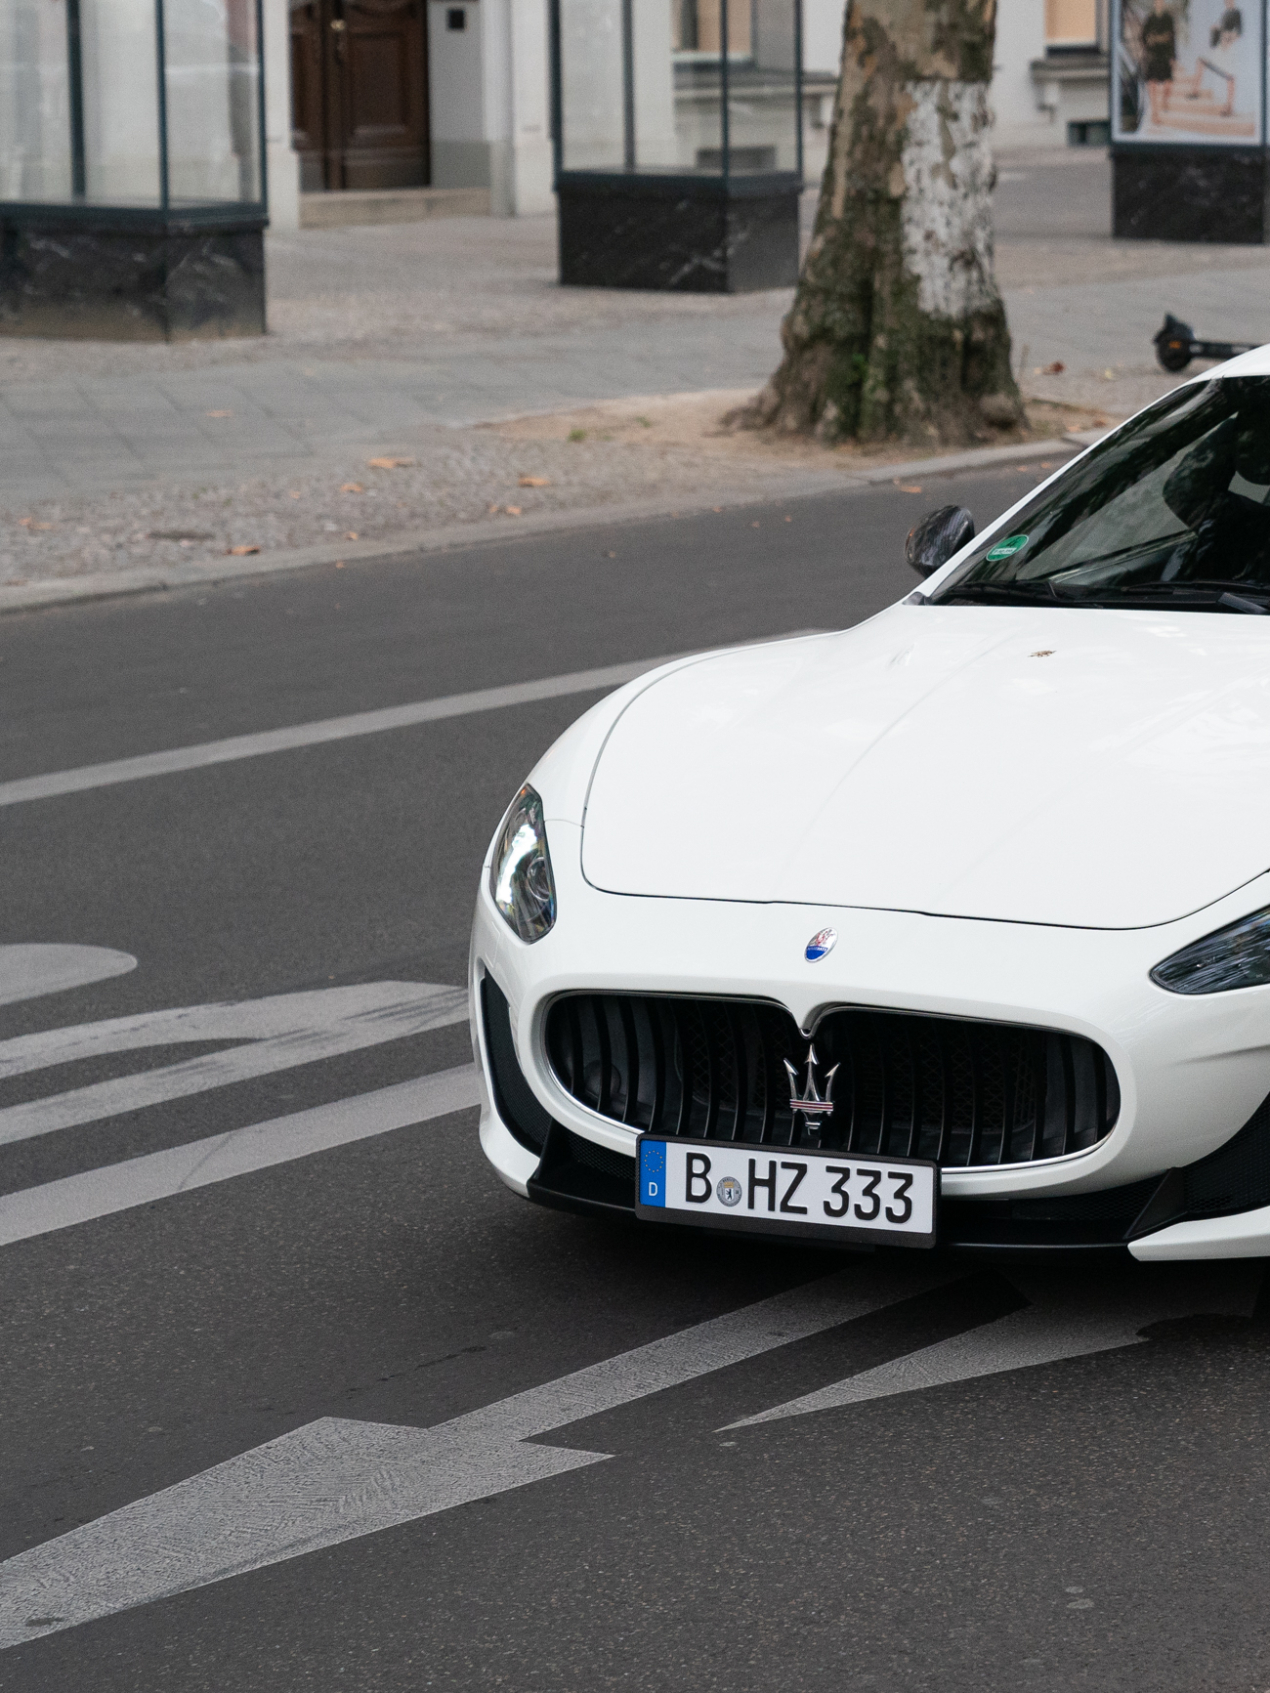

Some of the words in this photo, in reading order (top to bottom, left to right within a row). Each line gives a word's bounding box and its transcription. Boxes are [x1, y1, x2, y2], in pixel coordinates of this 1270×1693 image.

[648, 1182, 659, 1197] D
[685, 1152, 712, 1203] B
[747, 1158, 808, 1215] HZ
[823, 1166, 914, 1224] 333
